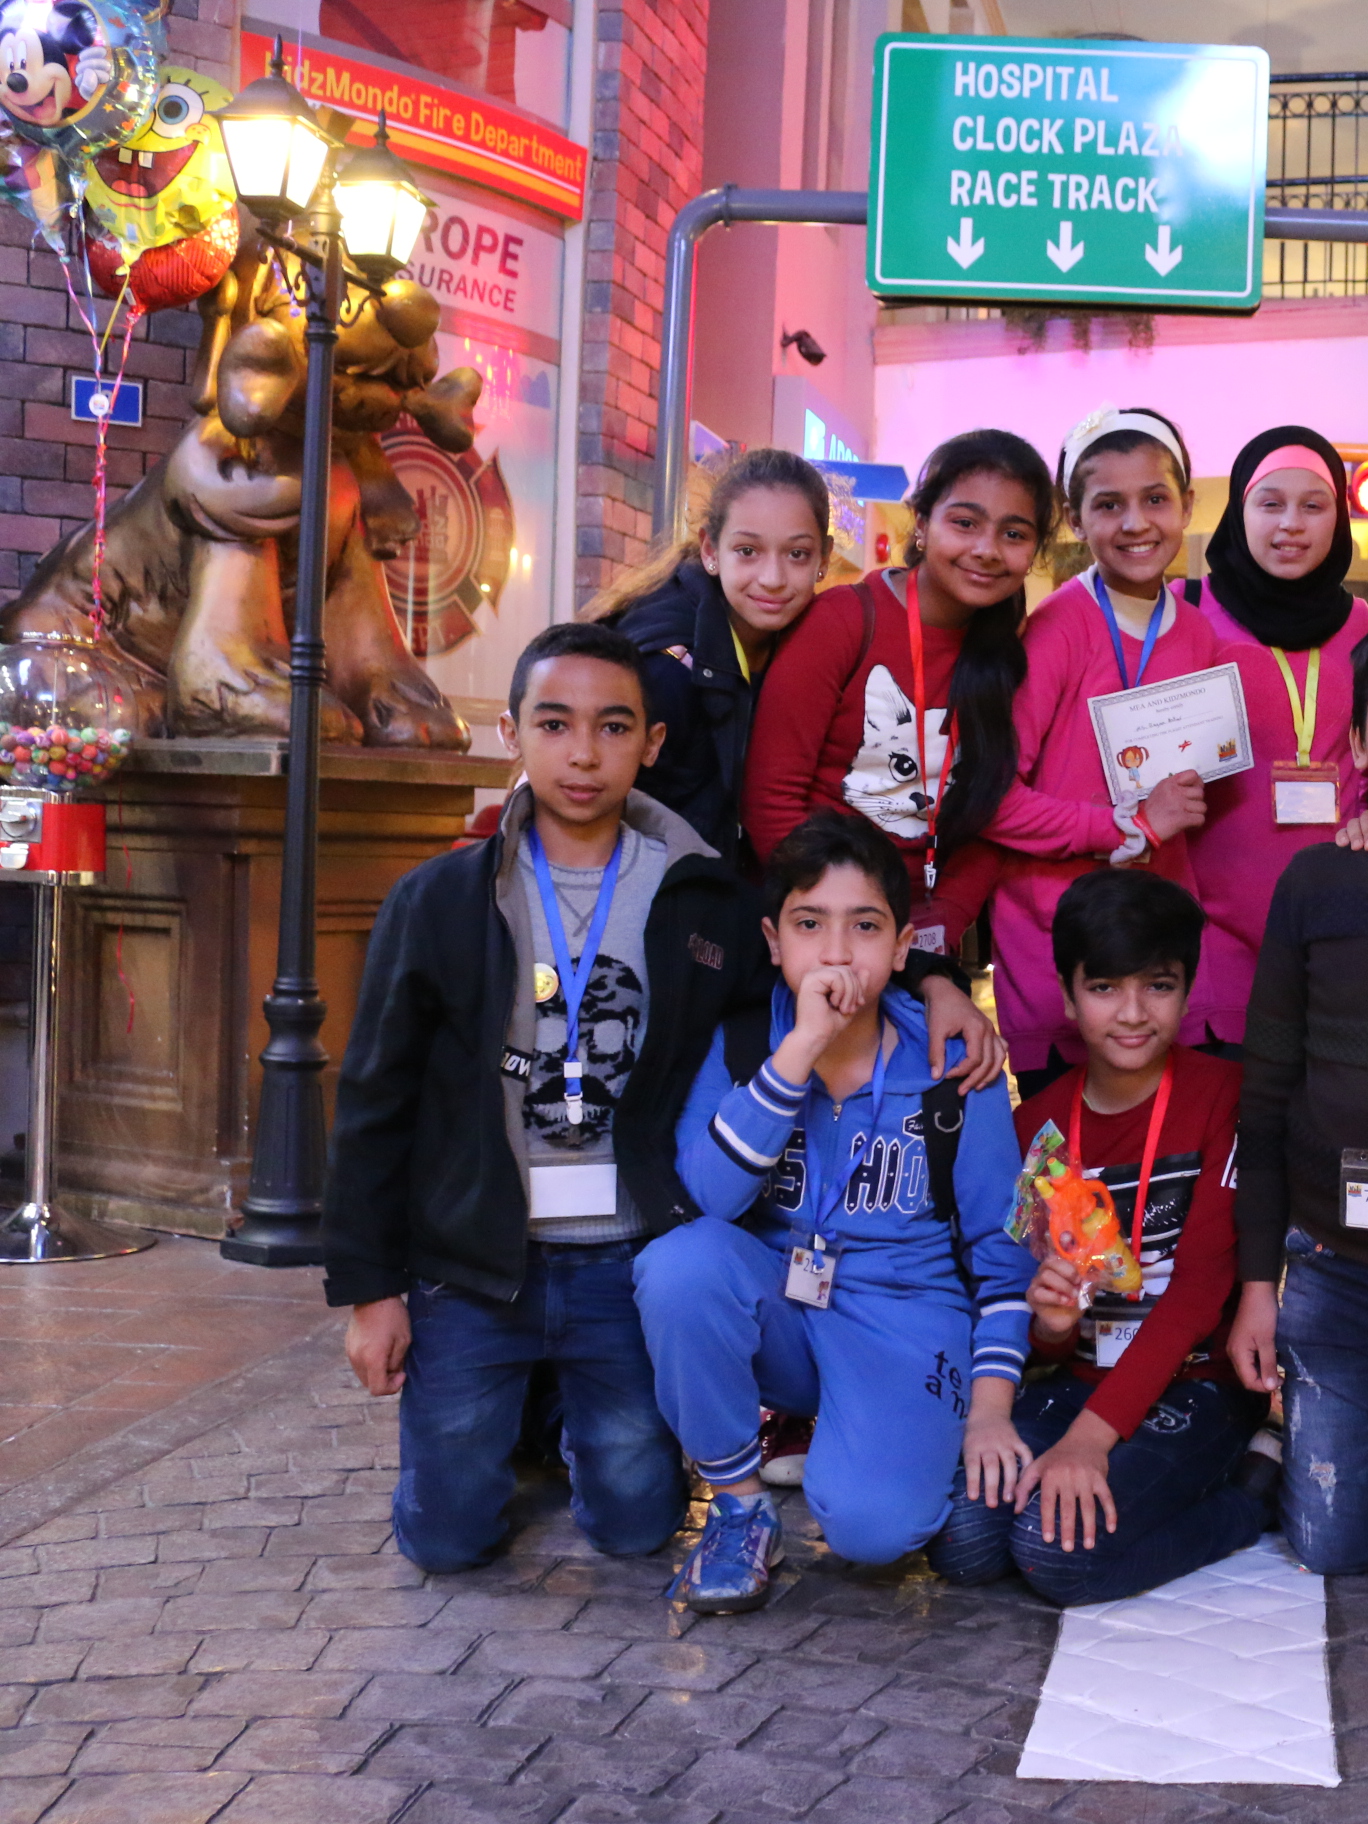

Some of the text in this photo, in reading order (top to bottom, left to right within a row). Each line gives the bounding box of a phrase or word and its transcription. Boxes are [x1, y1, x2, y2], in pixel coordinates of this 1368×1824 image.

[954, 60, 1119, 103] HOSPITAL
[419, 94, 465, 136] Fire
[470, 111, 583, 182] Department
[951, 115, 1184, 157] CLOCK PLAZA
[950, 170, 1159, 213] RACE TRACK
[1147, 699, 1163, 708] AND
[1163, 687, 1206, 703] KIDZMONDO
